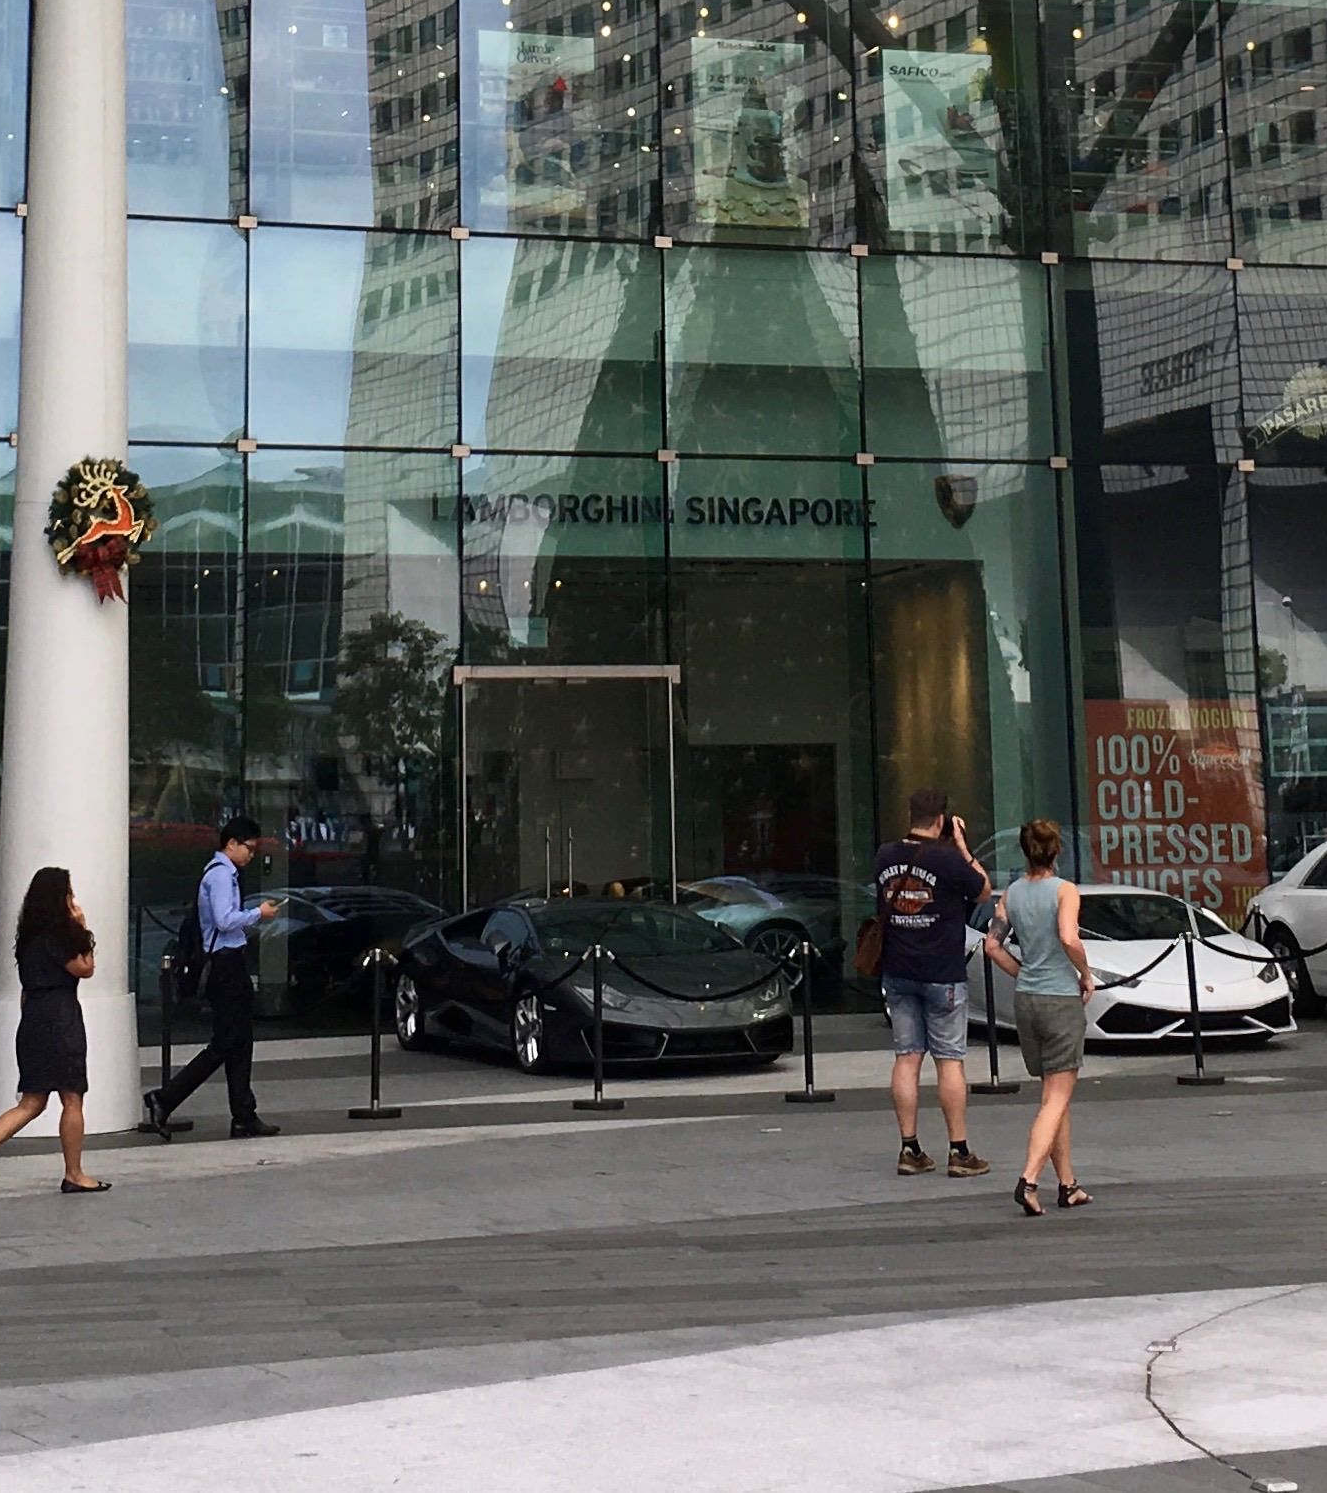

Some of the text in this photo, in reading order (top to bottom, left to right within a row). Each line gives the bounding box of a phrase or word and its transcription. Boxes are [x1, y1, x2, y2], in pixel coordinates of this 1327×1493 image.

[685, 495, 877, 527] SINGAPORE
[1097, 734, 1181, 776] 100%
[1097, 779, 1200, 821] COLD-
[1100, 822, 1253, 866] PRESSED
